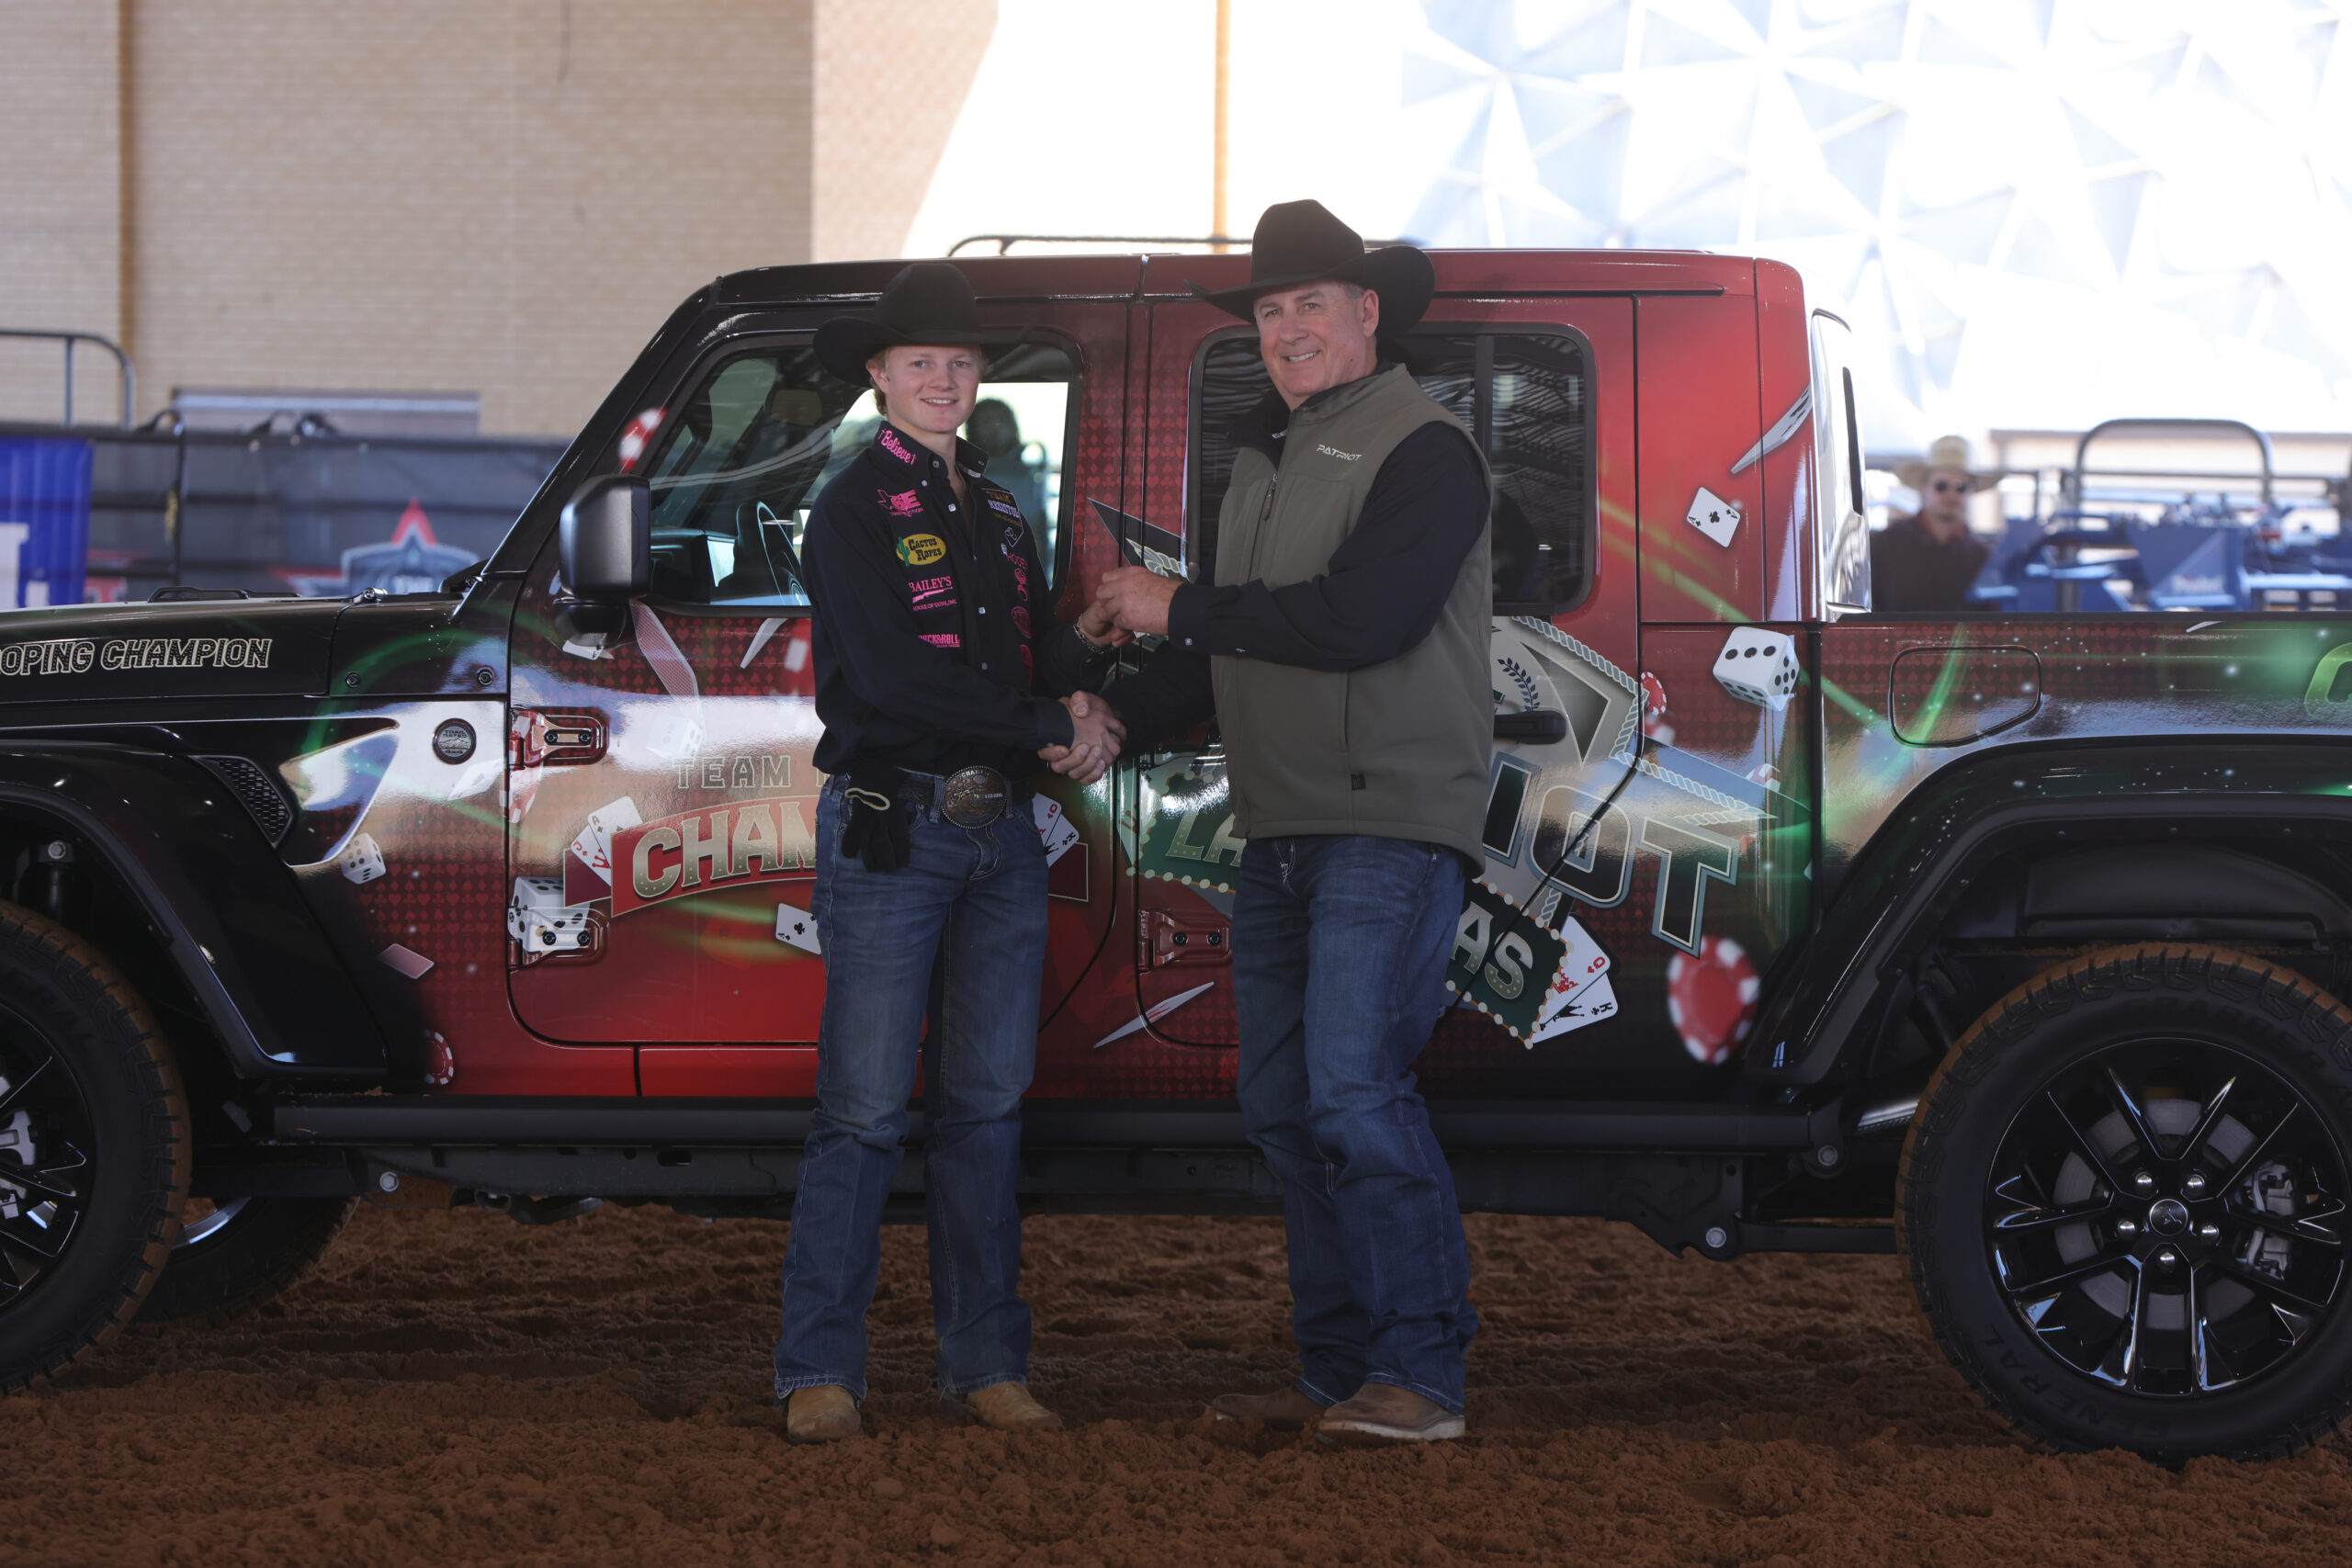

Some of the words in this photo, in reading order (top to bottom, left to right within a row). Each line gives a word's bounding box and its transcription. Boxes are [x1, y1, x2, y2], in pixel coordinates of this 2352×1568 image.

[1316, 444, 1363, 460] PATRIOT
[909, 538, 938, 551] CACTUS
[916, 548, 943, 561] ROPES
[908, 576, 953, 592] BAILEY'S
[0, 642, 95, 676] OPING
[101, 638, 273, 670] CHAMPION
[672, 755, 792, 789] TEAM
[632, 801, 817, 898] CHAM
[1481, 750, 1742, 959] IOT
[1450, 900, 1533, 999] AS
